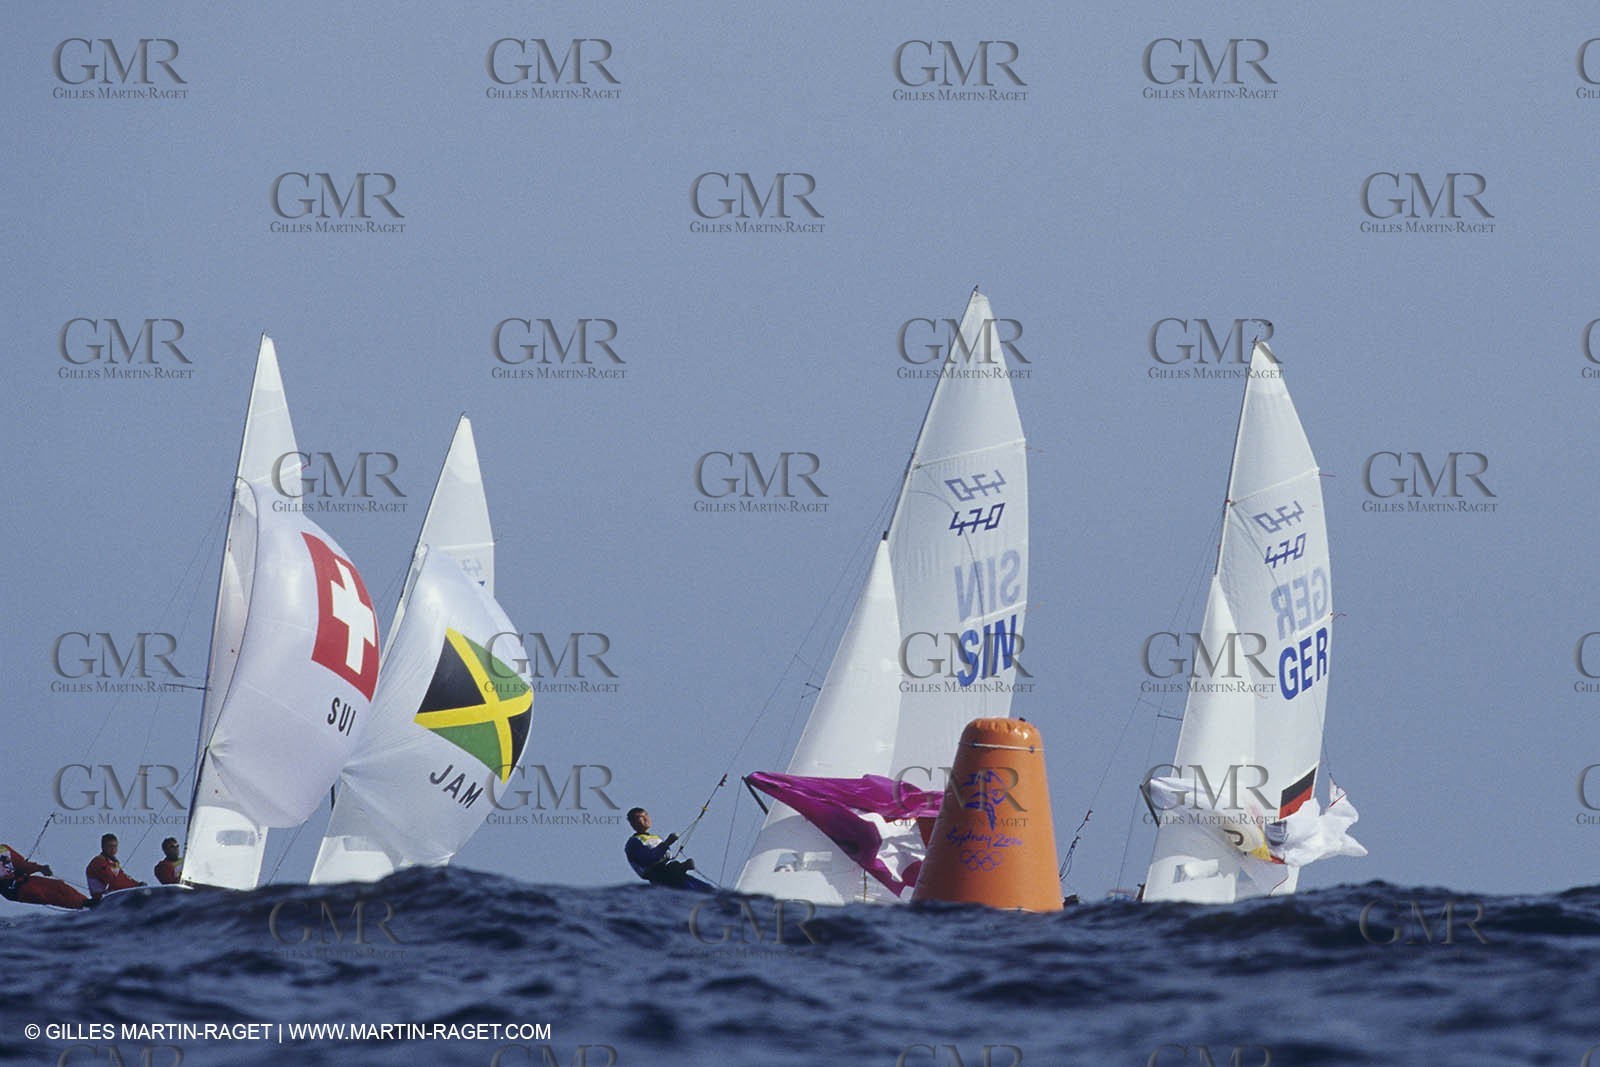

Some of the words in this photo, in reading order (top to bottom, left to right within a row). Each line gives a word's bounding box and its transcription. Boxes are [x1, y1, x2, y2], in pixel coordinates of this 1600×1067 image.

[948, 502, 1006, 536] 470
[1264, 533, 1307, 568] 470
[957, 614, 1017, 687] SIN
[1278, 627, 1329, 700] GER
[327, 697, 357, 737] SUI
[429, 764, 484, 809] JAM
